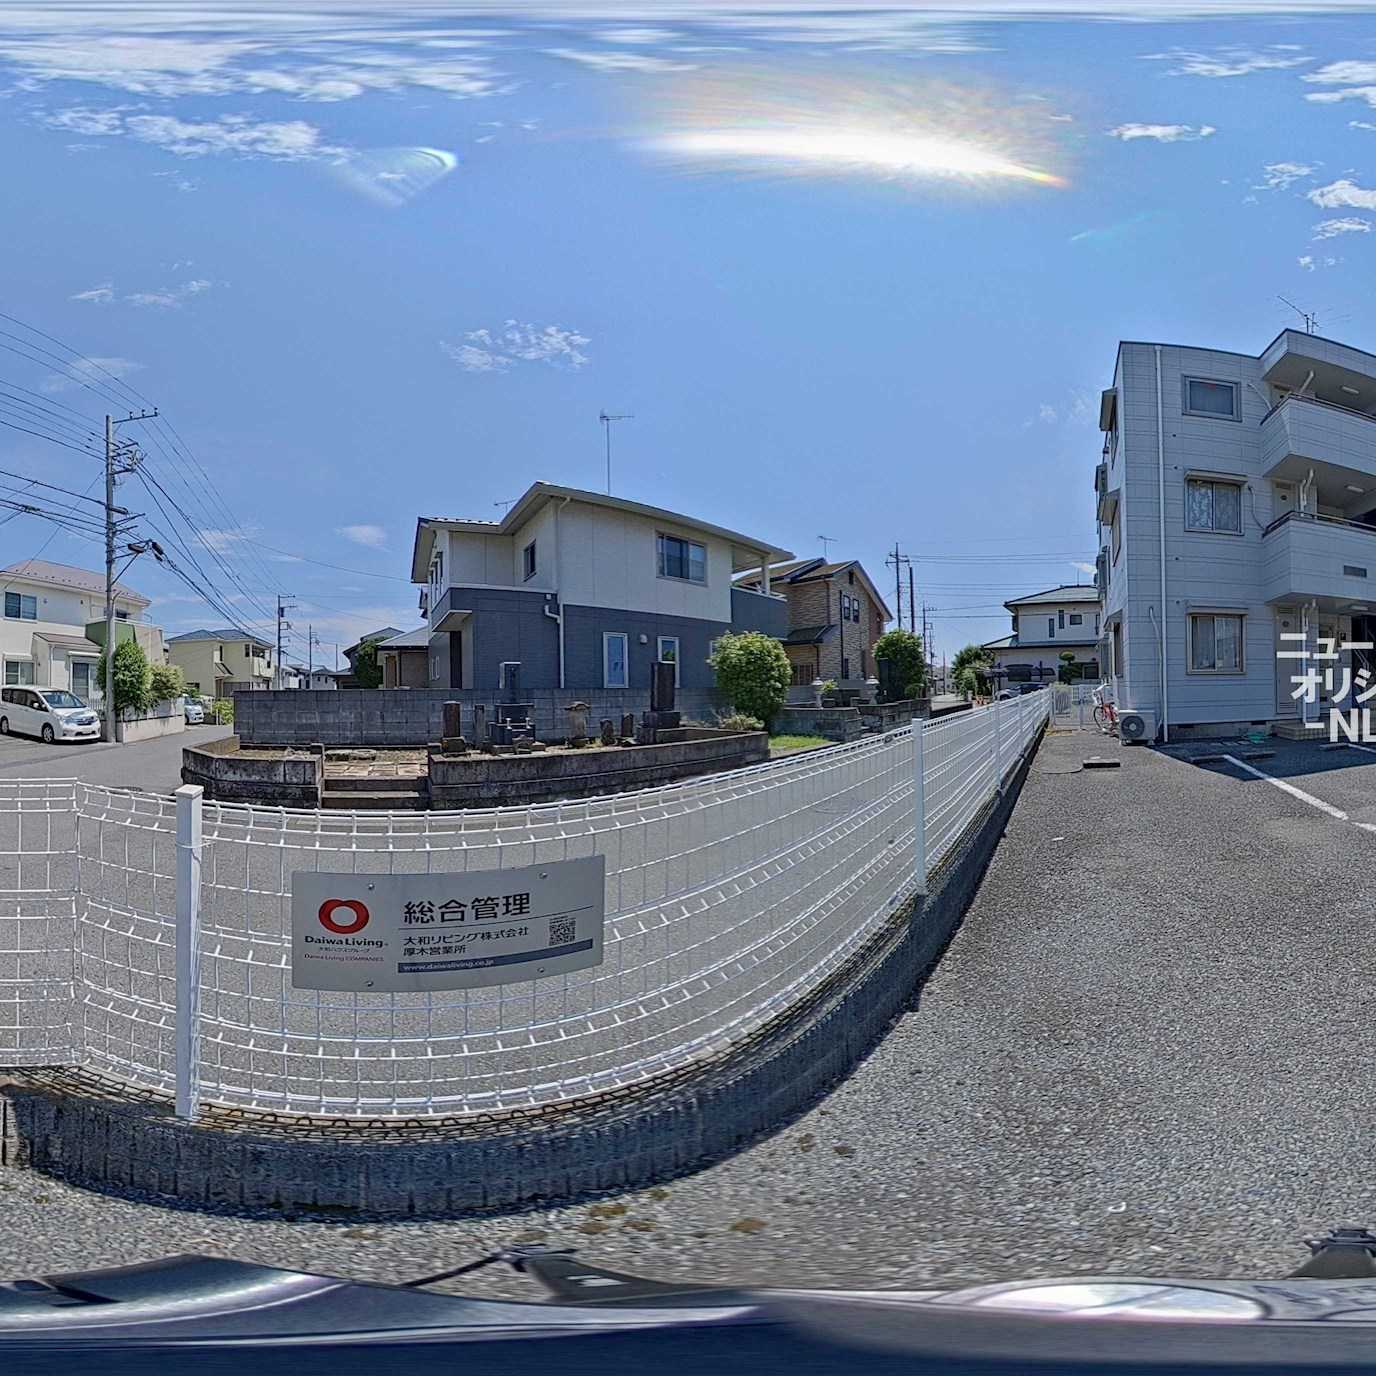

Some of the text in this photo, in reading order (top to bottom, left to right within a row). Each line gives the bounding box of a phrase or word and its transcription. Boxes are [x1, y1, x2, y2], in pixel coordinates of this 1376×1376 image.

[403, 892, 531, 925] 総合管理
[304, 935, 384, 949] Daiwa Living
[403, 926, 529, 946] 大和リビング株式会社
[403, 944, 467, 957] 厚木営業所
